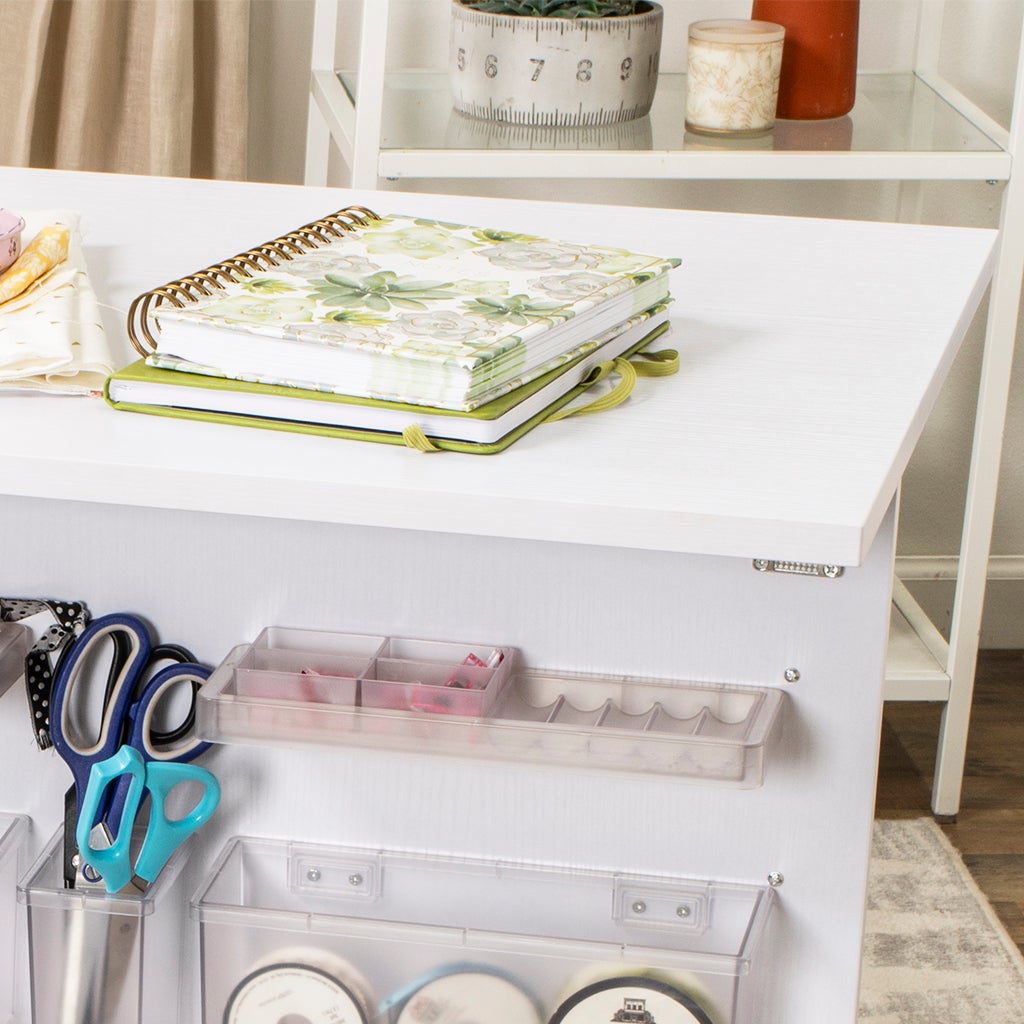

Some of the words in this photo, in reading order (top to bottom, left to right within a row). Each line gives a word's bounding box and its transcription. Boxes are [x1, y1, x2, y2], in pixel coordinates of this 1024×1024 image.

[456, 48, 466, 71] 5
[484, 54, 498, 79] 6
[529, 59, 545, 82] 7
[576, 59, 593, 82] 8
[620, 57, 633, 80] 9
